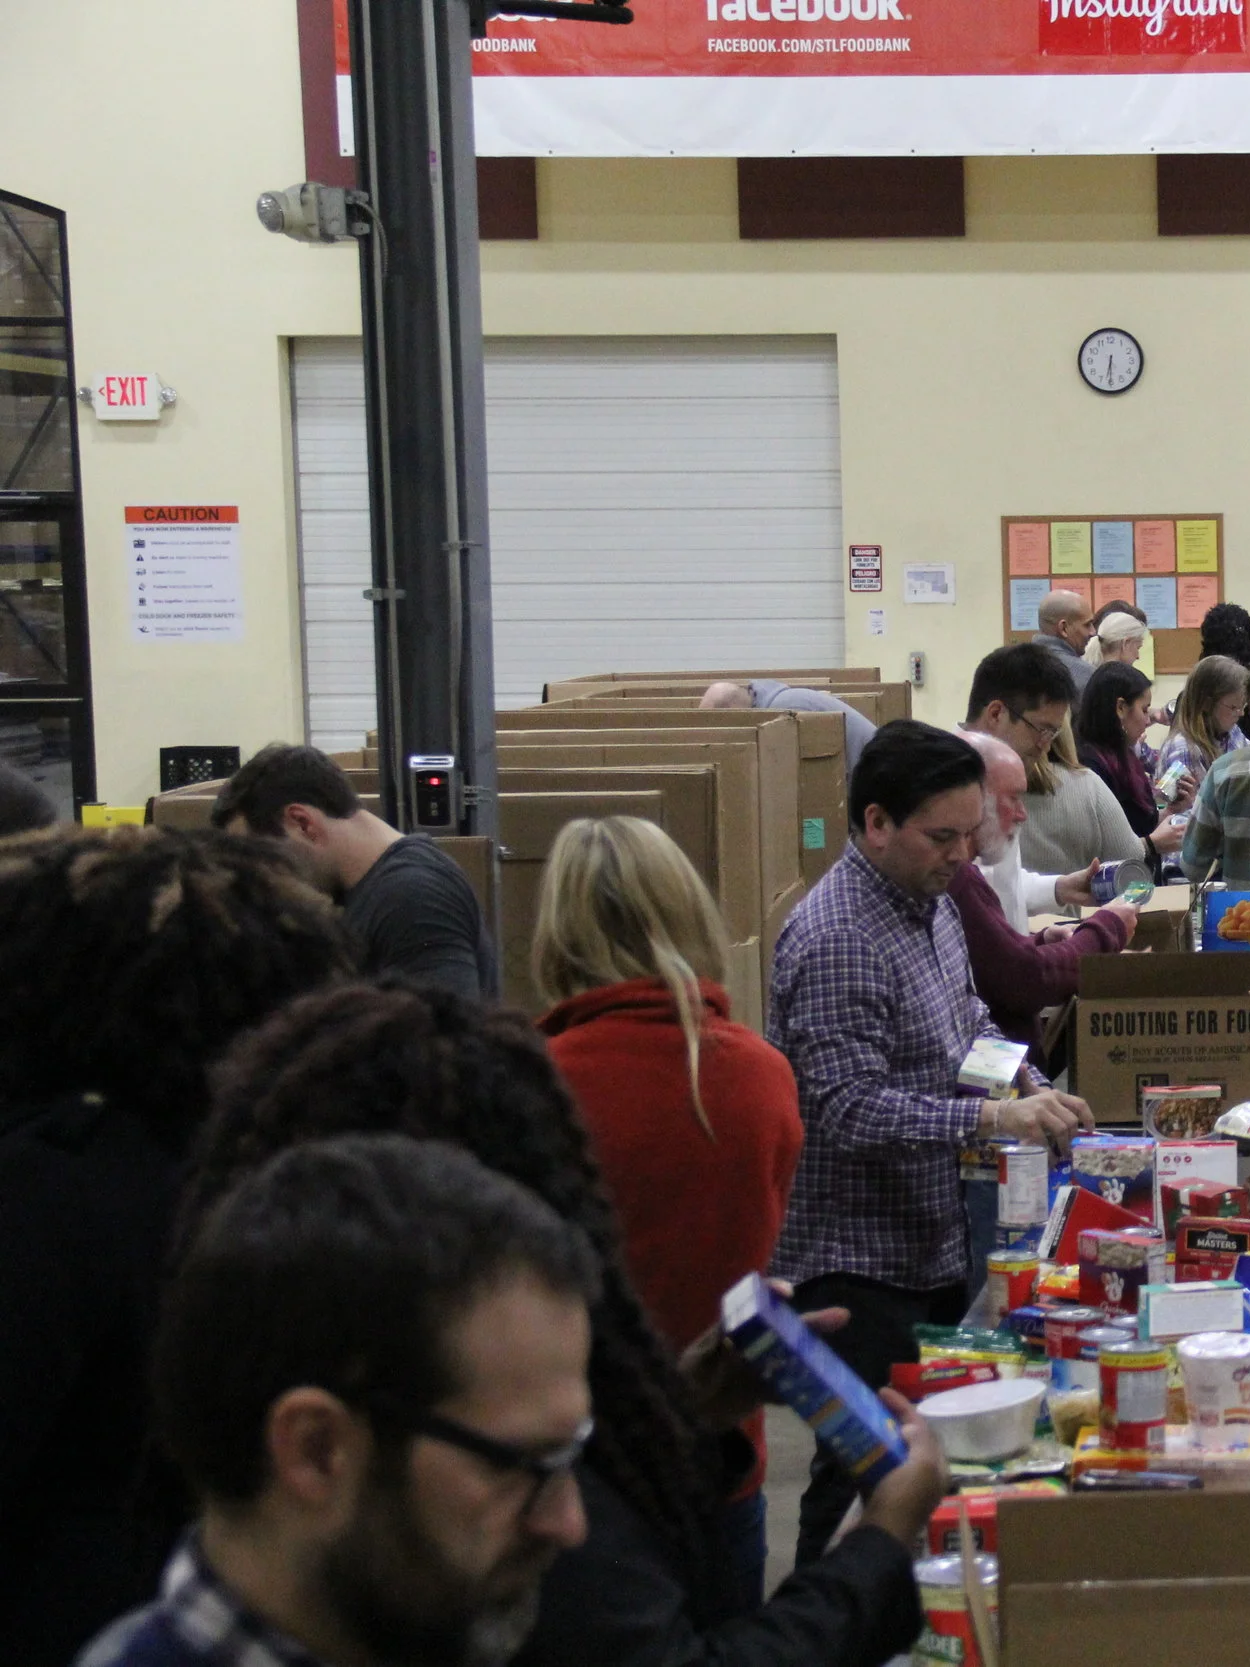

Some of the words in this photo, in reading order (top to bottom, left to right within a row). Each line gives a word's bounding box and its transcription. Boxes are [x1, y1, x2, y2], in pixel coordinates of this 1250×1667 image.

[470, 38, 537, 52] OODBANK
[707, 38, 911, 53] FACEBOOK.COM/STLFOODBANK
[105, 377, 148, 406] EXIT
[143, 507, 220, 522] CAUTION
[1090, 1010, 1178, 1037] SCOUTING
[1186, 1009, 1218, 1035] FOR
[1197, 1238, 1237, 1249] MASTERS
